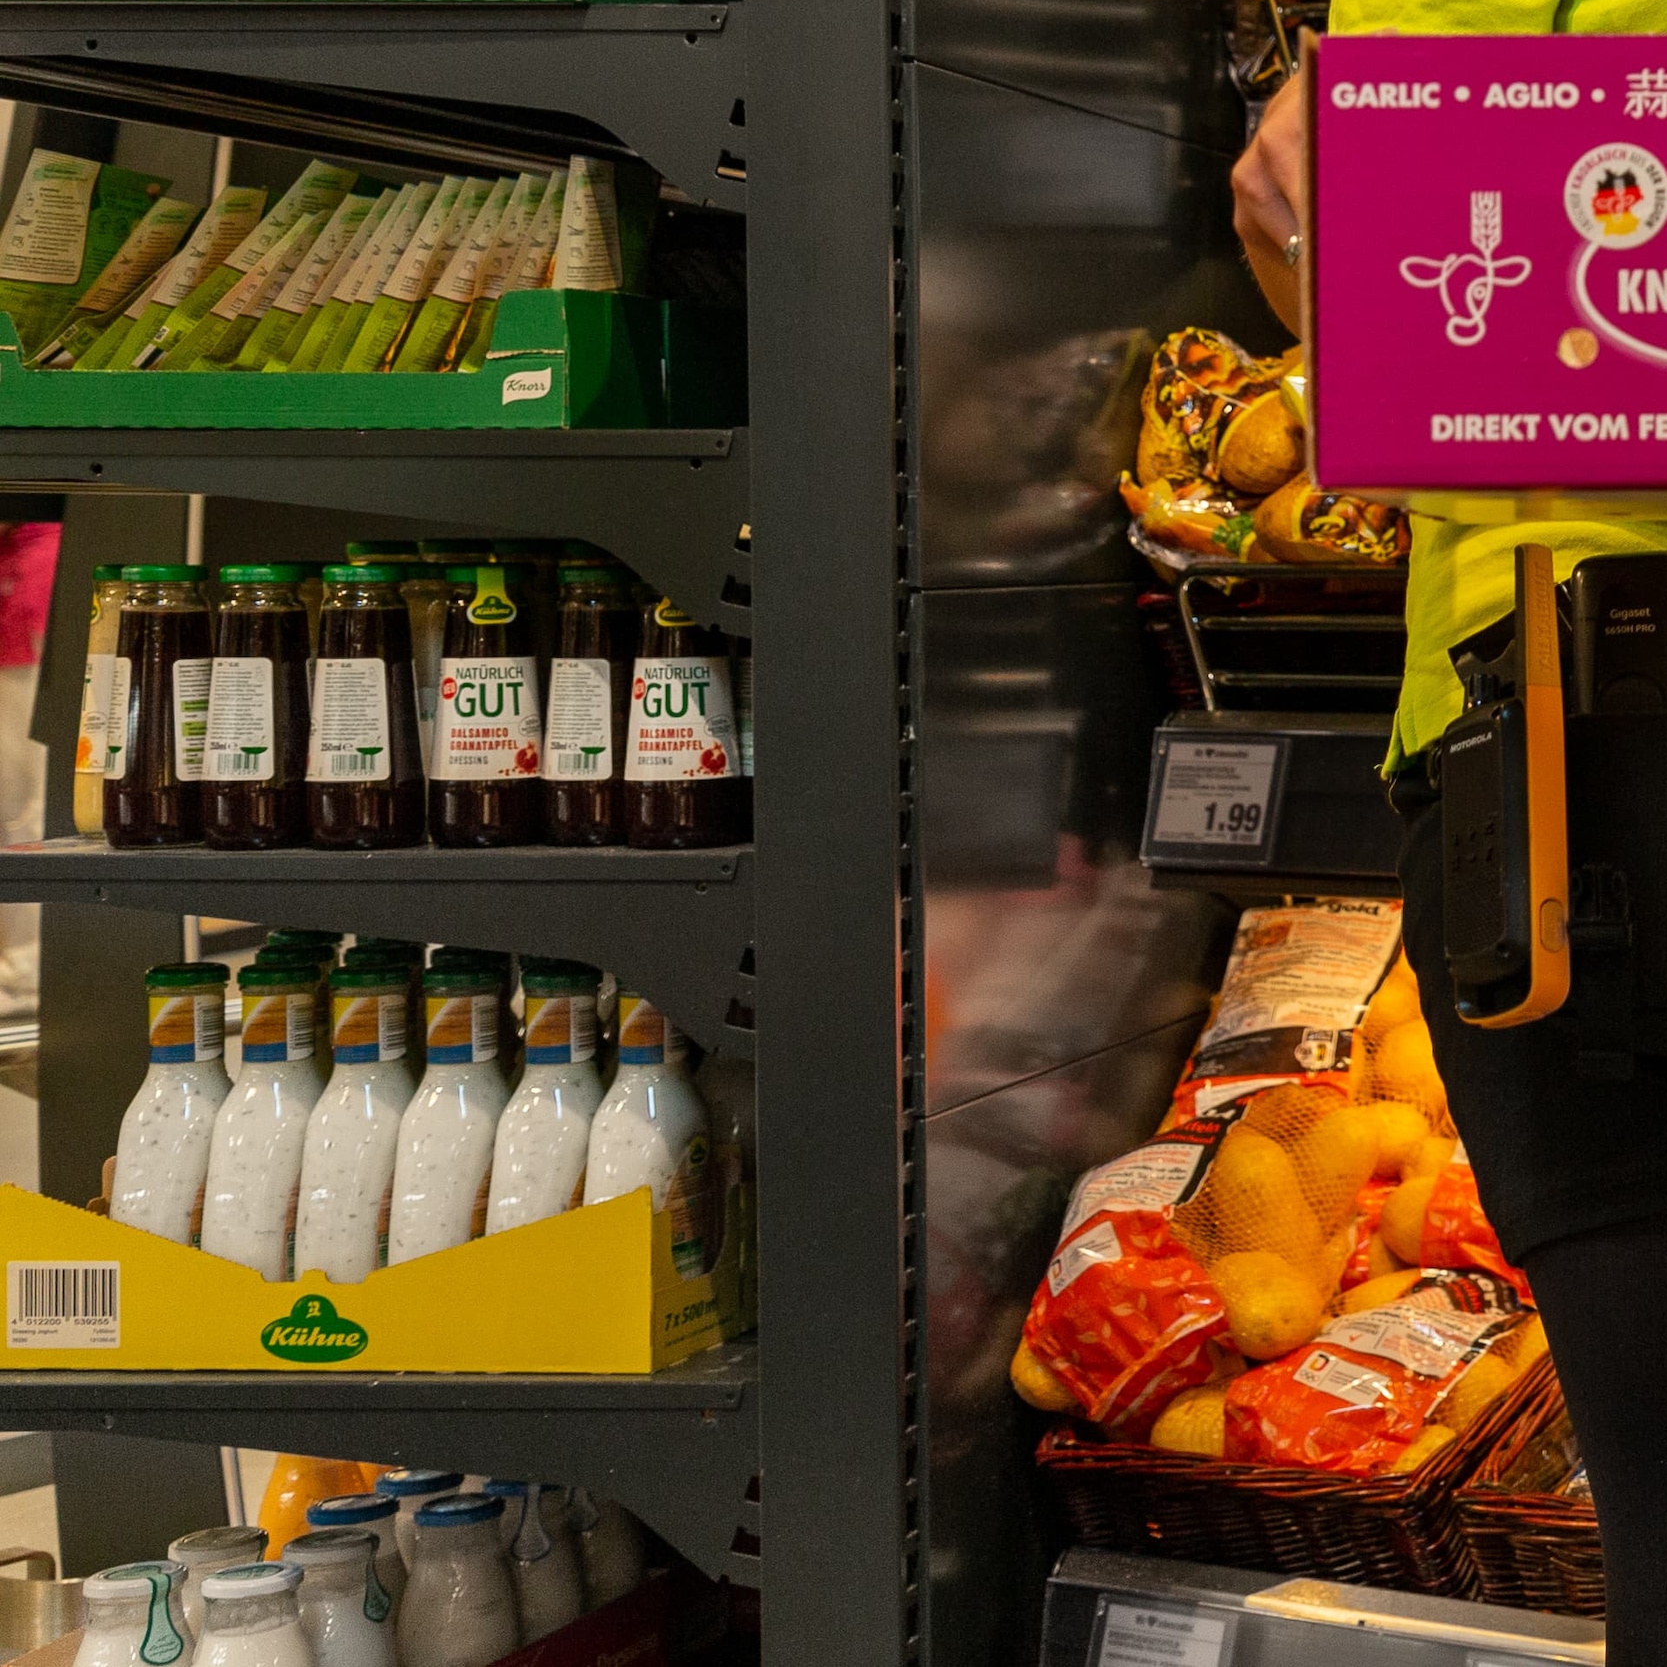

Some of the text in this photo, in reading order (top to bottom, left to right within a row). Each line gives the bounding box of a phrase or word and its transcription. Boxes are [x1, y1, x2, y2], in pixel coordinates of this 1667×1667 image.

[1331, 82, 1441, 109] GARLIC
[1483, 82, 1580, 109] AGLIO
[506, 379, 546, 391] Knorr
[1431, 414, 1541, 441] DIREKT
[1548, 413, 1630, 441] VOM
[455, 665, 524, 679] NATÜRLICH
[644, 665, 710, 680] NATÜRLICH
[455, 682, 524, 717] GUT
[643, 682, 710, 718] GUT
[450, 728, 509, 738] BALSAMICO
[640, 728, 694, 739] BALSAMICO
[450, 740, 519, 750] GRANATAPFEL
[638, 740, 704, 751] GRANATAPFEL
[1450, 731, 1492, 753] MOTOROLA
[449, 755, 489, 765] DRESSING
[637, 756, 673, 765] DRESSING
[1205, 802, 1261, 832] 1.99
[11, 1318, 17, 1326] 4
[26, 1318, 62, 1326] 012200
[268, 1326, 360, 1347] Kühne
